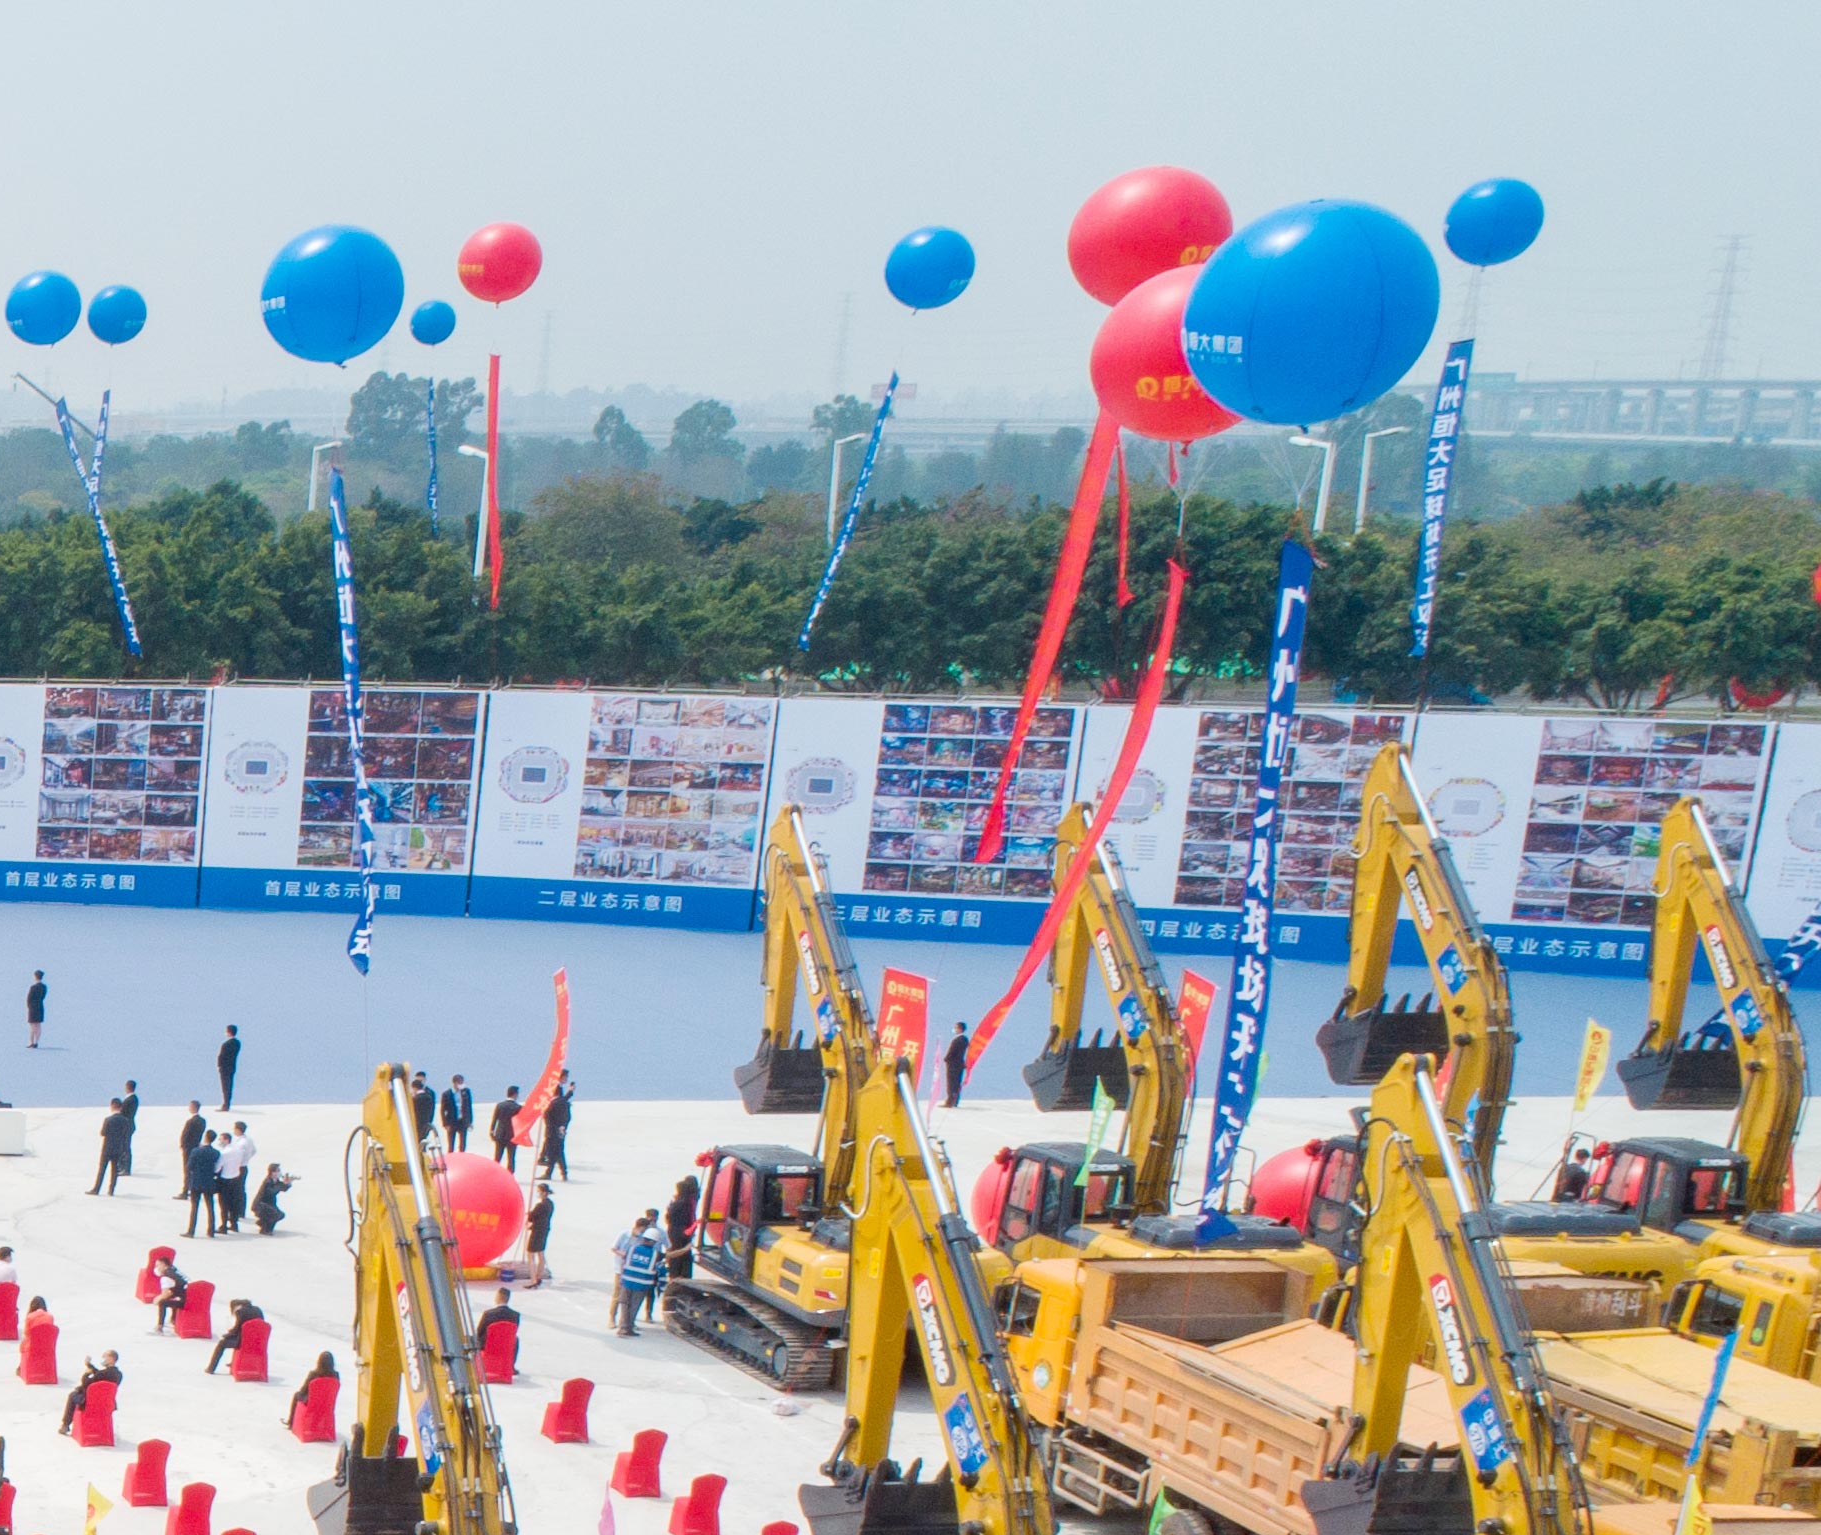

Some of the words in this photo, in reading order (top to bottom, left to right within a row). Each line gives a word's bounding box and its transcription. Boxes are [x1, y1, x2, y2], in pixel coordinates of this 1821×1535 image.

[5, 871, 136, 890] 首层业态示意图
[539, 891, 682, 912] 二层业态示意图
[920, 1305, 951, 1385] XCMG
[1440, 1307, 1470, 1386] XCMG
